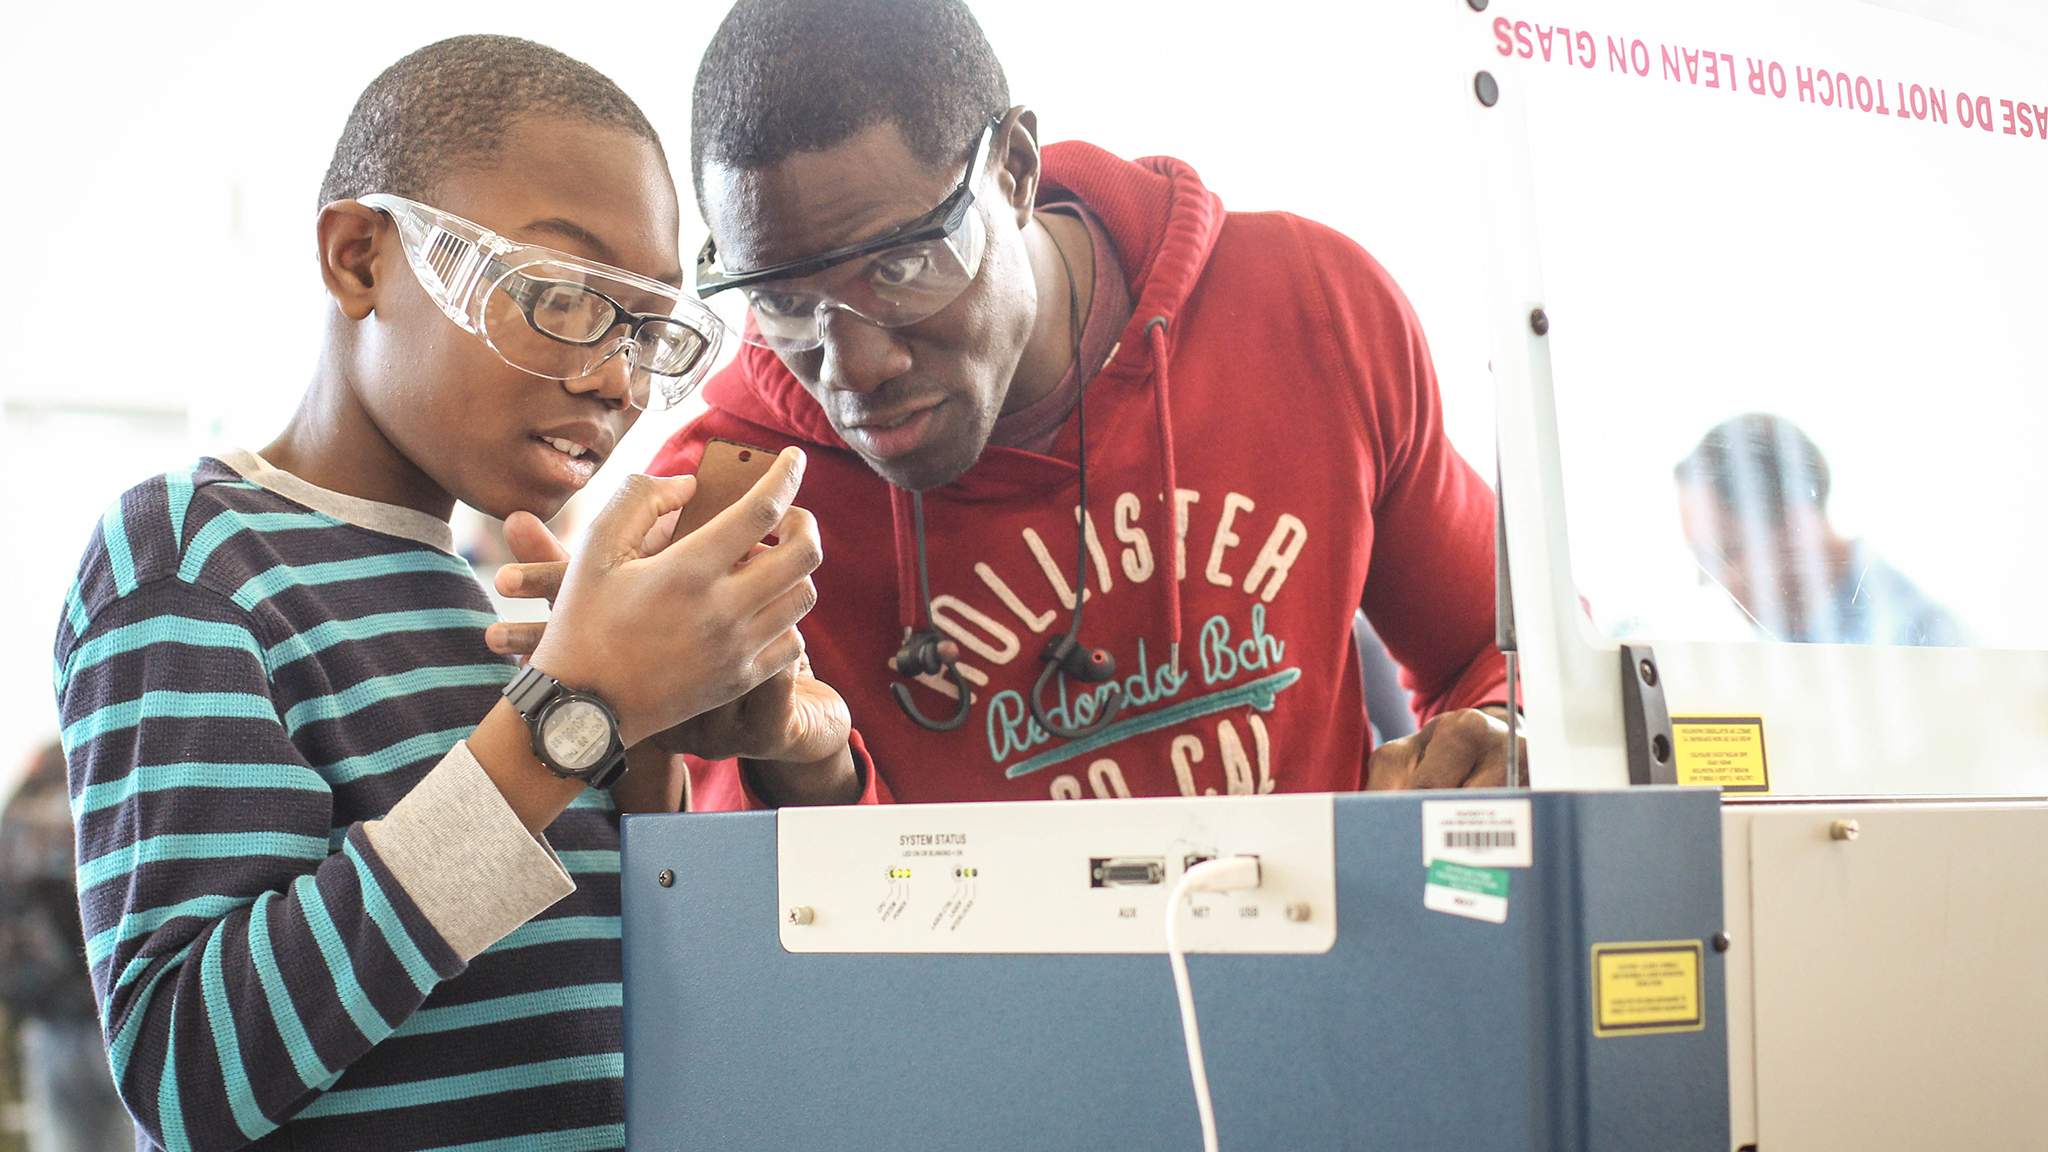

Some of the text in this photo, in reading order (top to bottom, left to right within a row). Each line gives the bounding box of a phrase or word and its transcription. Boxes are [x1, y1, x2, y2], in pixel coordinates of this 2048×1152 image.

[1492, 16, 2048, 140] ASE DO NOT TOUCH OR LEAN ON GLASS
[987, 604, 1285, 762] Redondo Bch
[899, 833, 967, 846] SYSTEM STATUS
[1118, 907, 1137, 918] AUX
